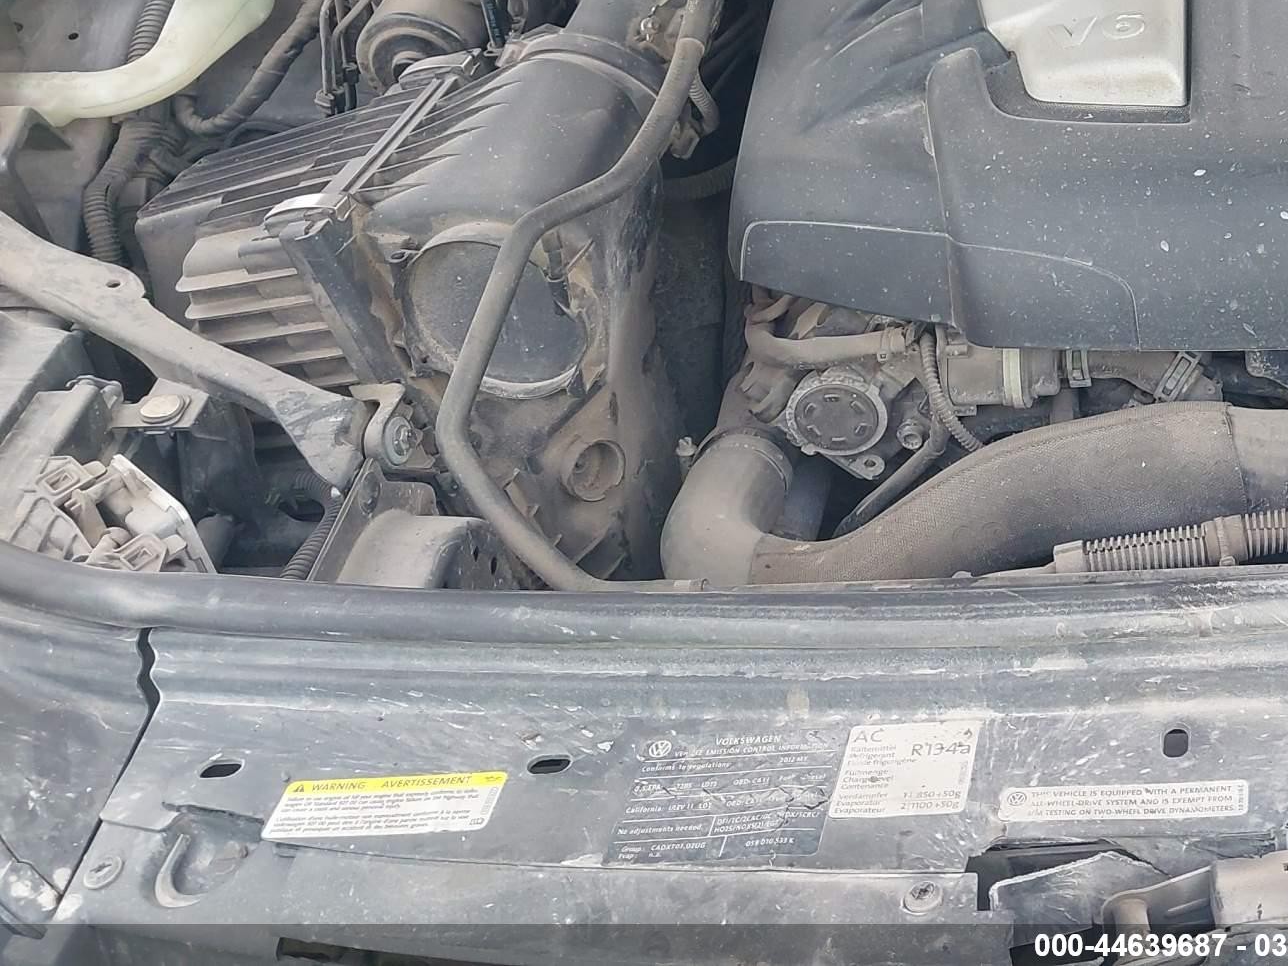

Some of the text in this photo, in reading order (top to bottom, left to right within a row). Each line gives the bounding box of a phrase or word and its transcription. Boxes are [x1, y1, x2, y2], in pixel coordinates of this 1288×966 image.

[1047, 10, 1145, 49] V6
[715, 735, 782, 746] VOLKSWAGEN
[853, 729, 884, 743] AC
[742, 745, 776, 754] CONTROL
[911, 741, 971, 755] R134a
[641, 763, 675, 773] Conforms
[311, 775, 473, 792] WARNING AVERTISSEMENT
[1052, 790, 1087, 798] VEHICLE
[1100, 789, 1143, 797] EQUIPPED
[1180, 785, 1232, 794] PERMANENT
[1106, 798, 1137, 806] SYSTEM
[1161, 797, 1169, 805] IS
[1172, 796, 1205, 804] EXEMPT
[1207, 795, 1233, 803] FROM
[1094, 808, 1141, 816] TWO-WHEEL
[1143, 807, 1167, 815] DRIVE
[628, 825, 674, 837] adjustments
